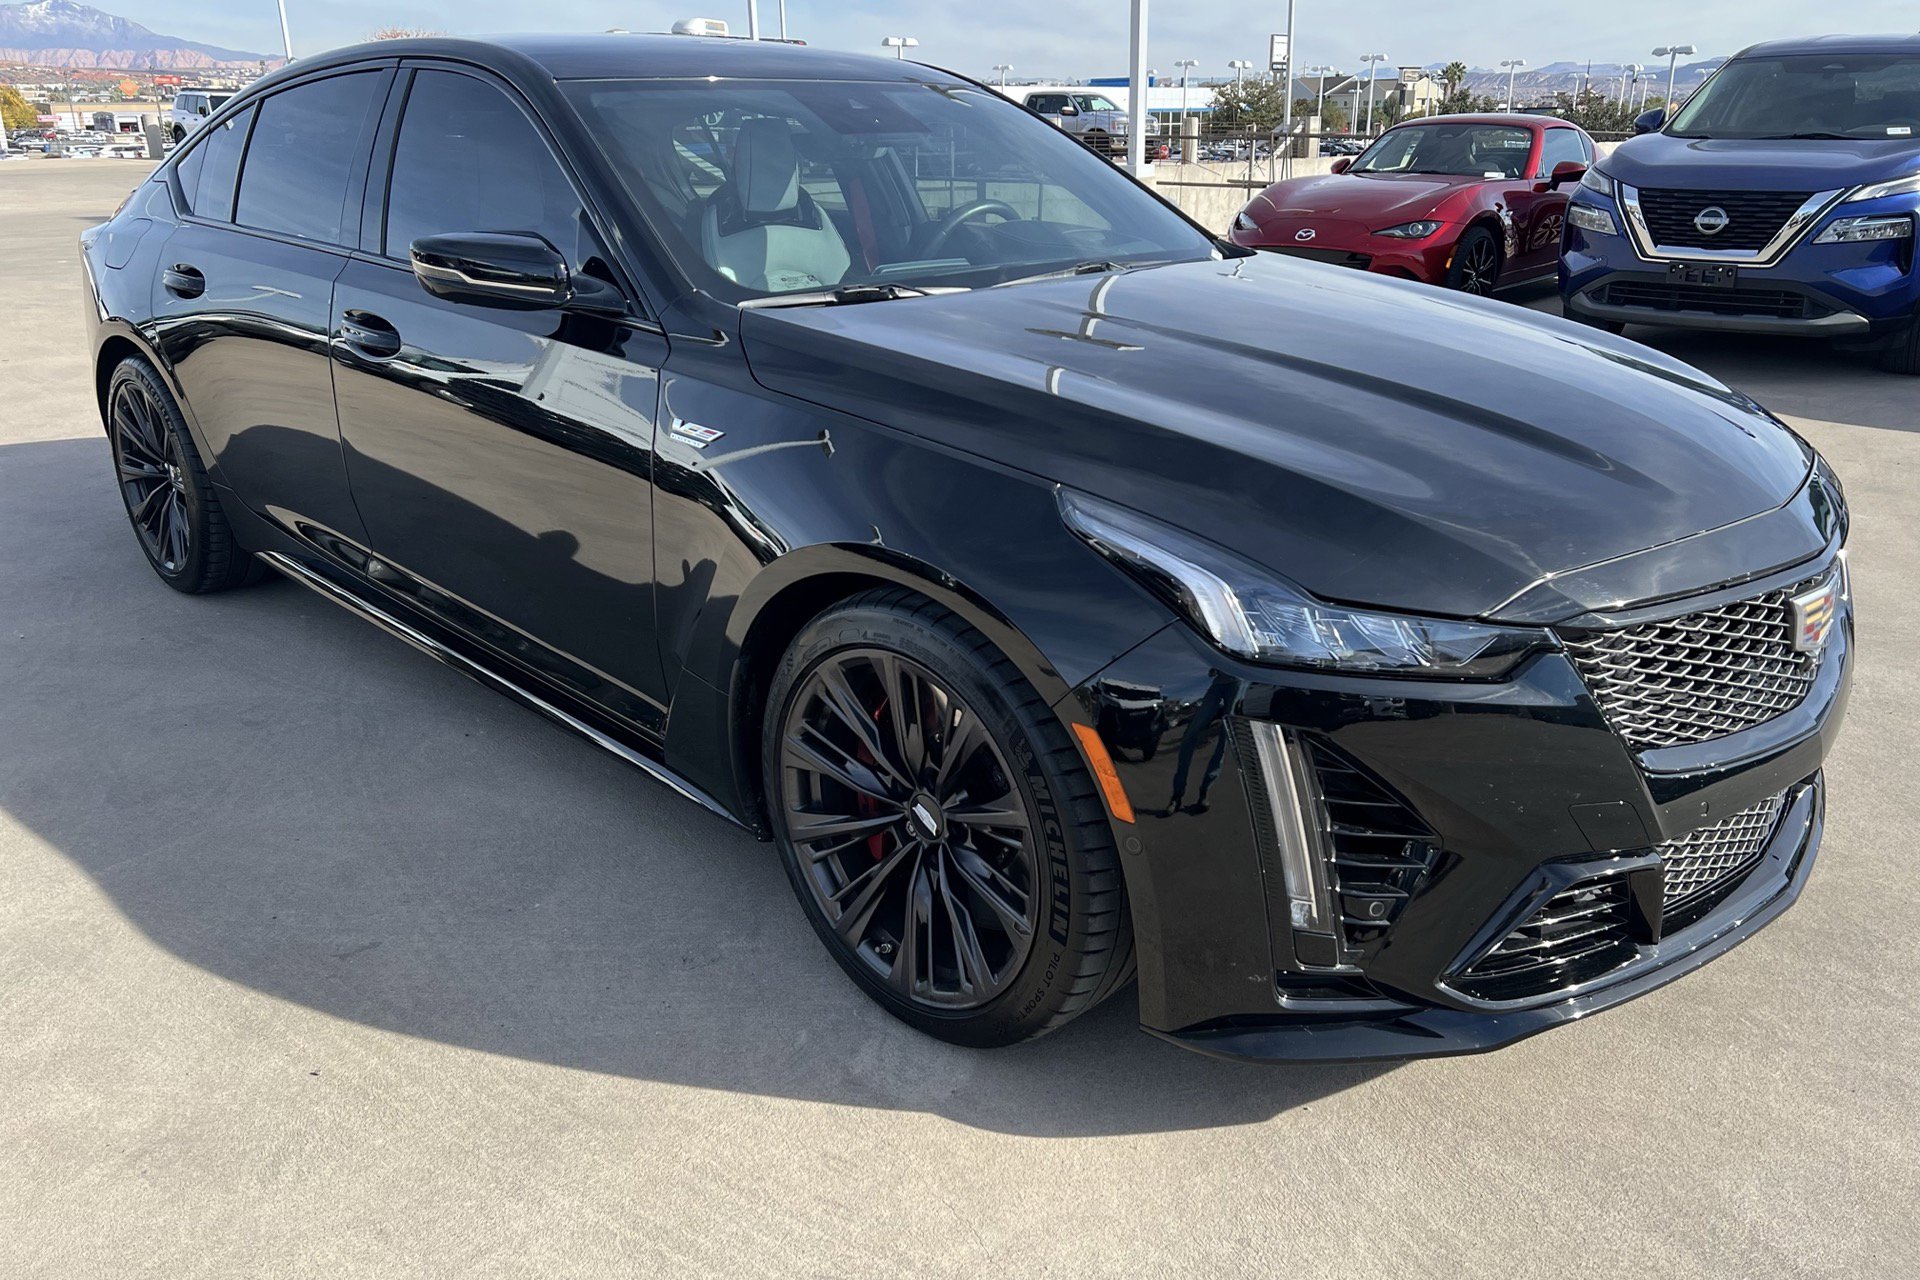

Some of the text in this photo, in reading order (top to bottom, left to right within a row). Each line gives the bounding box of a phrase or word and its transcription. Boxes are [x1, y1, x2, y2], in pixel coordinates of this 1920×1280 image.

[142, 378, 173, 430] MICHELIN
[1030, 775, 1069, 931] MICHELIN
[1019, 952, 1062, 1018] PILOT SPORT
